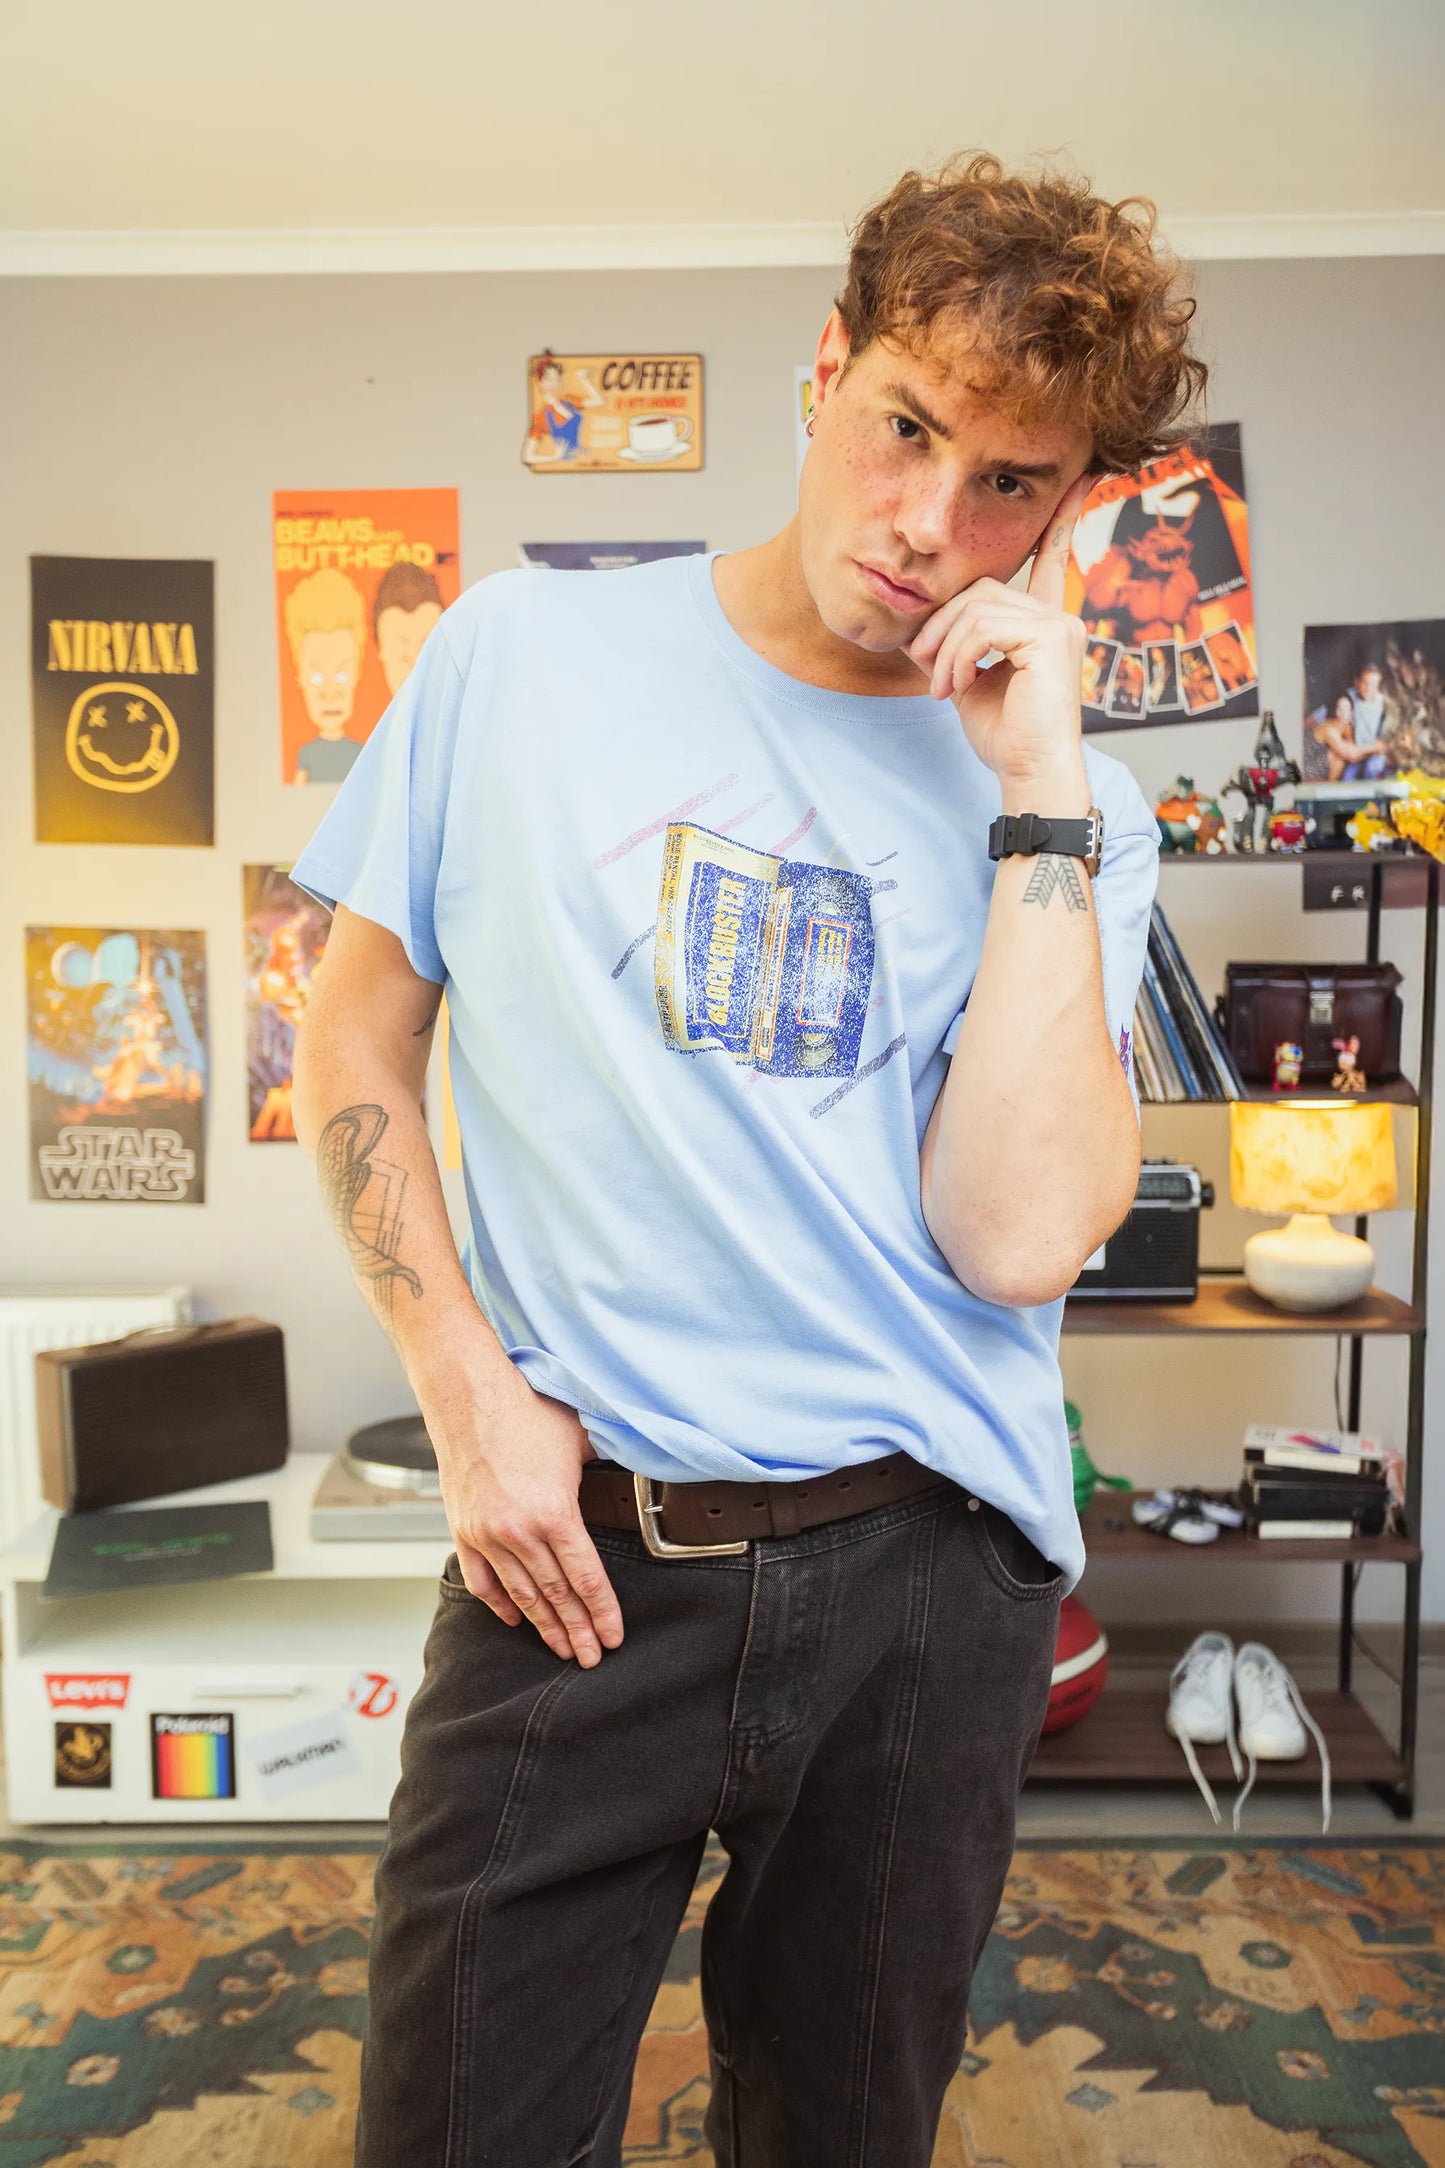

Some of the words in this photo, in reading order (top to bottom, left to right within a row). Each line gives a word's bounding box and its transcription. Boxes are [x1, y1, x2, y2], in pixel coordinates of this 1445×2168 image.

[603, 361, 696, 390] COFFEE
[275, 517, 373, 544] BEAVIS
[275, 542, 435, 570] BUTT-HEAD
[47, 619, 199, 675] NIRVANA
[706, 877, 745, 1026] BLOCKBUSTER
[39, 1126, 195, 1168] STAR
[40, 1162, 196, 1201] WARS
